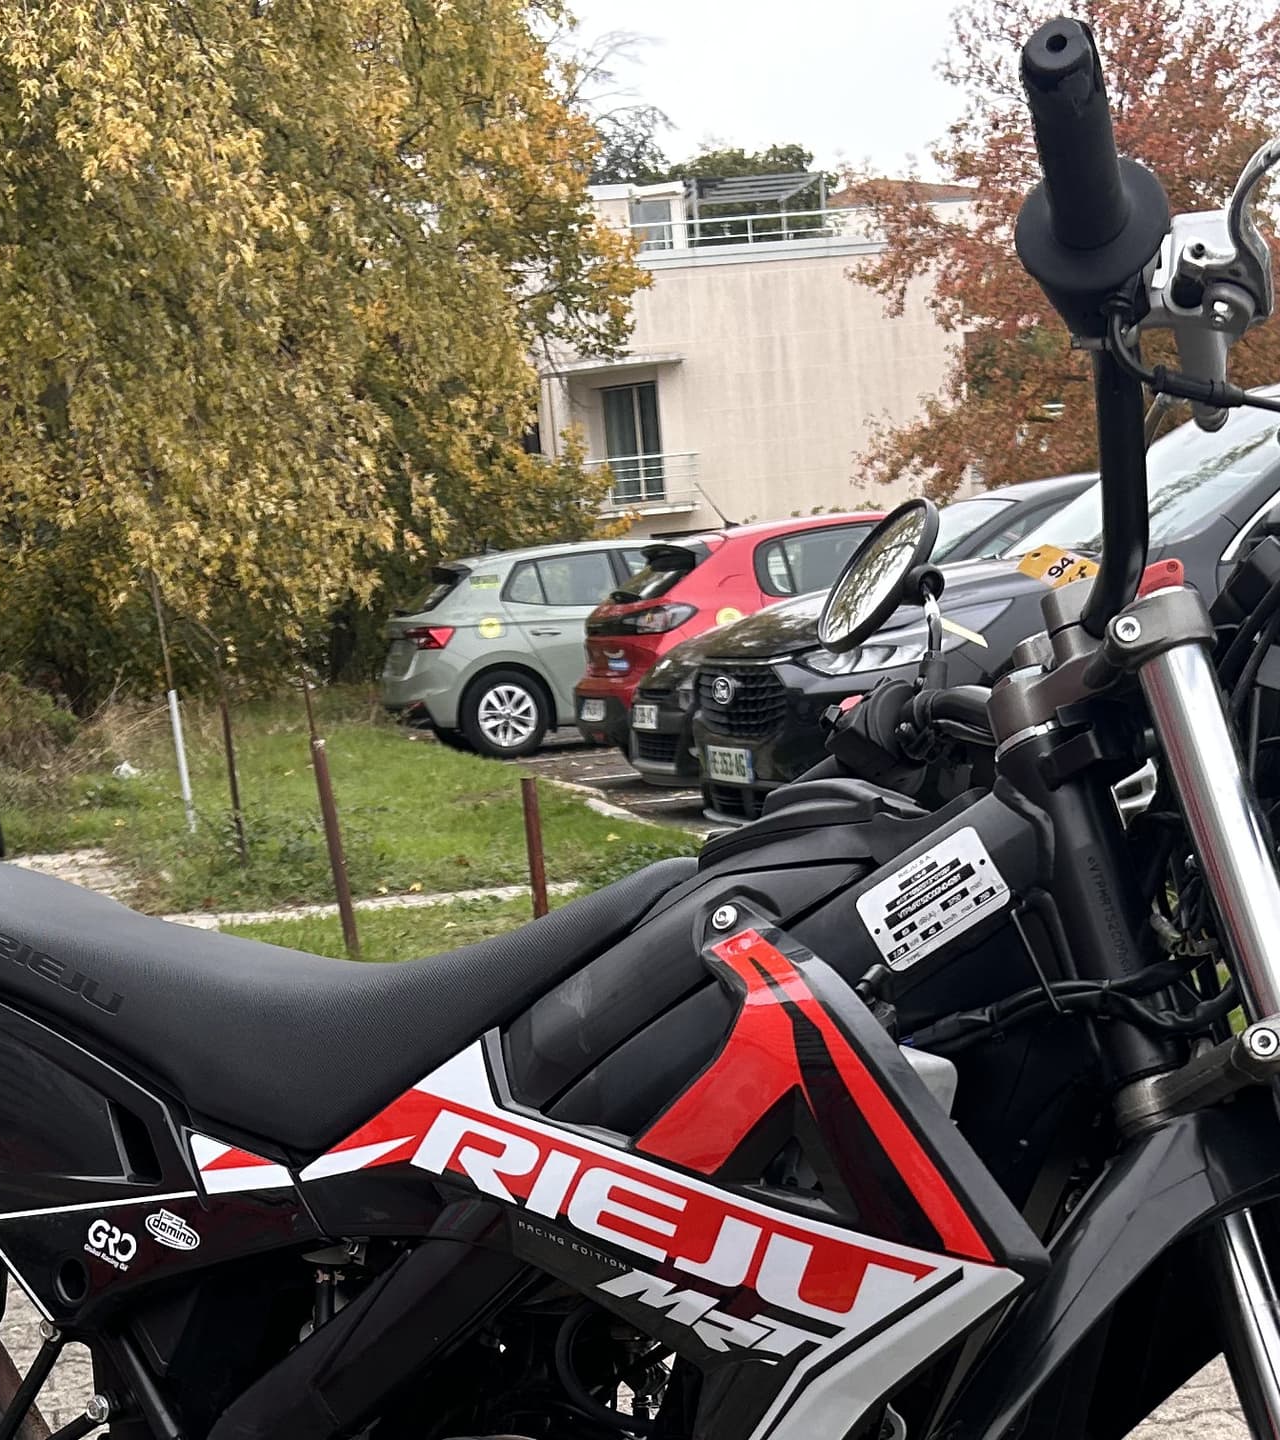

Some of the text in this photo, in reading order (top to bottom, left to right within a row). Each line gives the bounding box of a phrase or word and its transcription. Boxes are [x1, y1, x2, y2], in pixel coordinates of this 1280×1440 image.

[1047, 556, 1077, 579] 94
[88, 1219, 137, 1262] GRO
[410, 1109, 919, 1332] RIEJU
[518, 1220, 627, 1272] RACING EDITION
[596, 1269, 823, 1357] MRT
